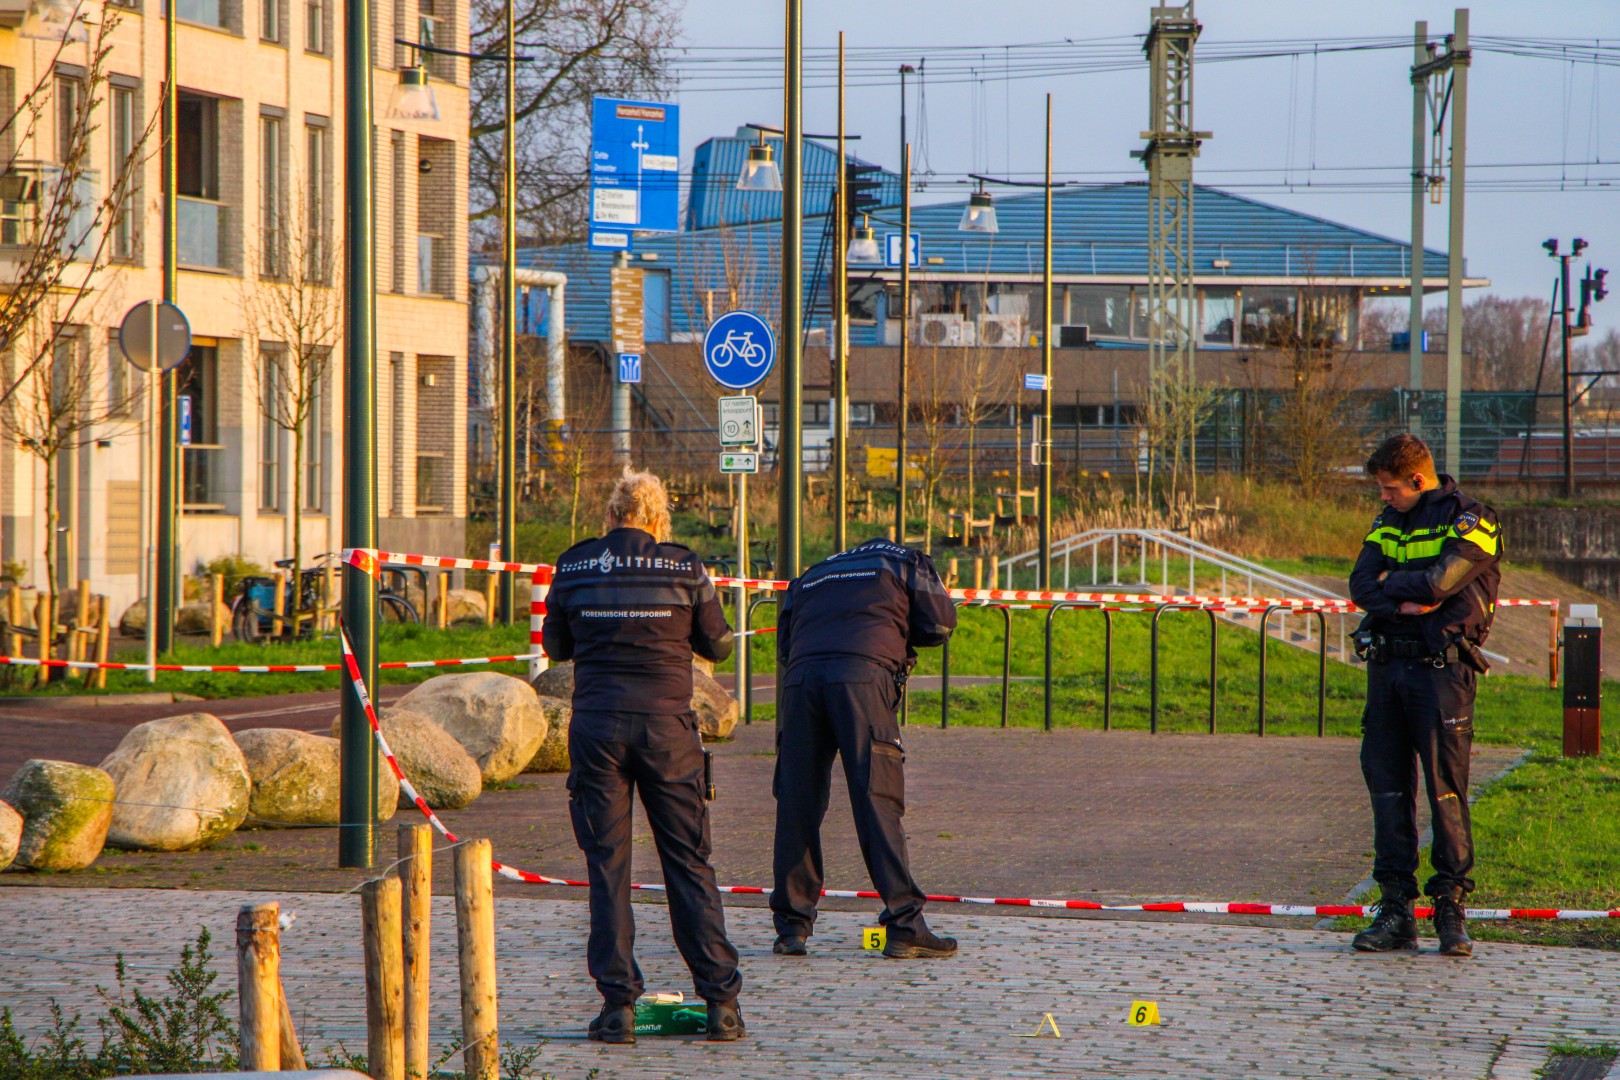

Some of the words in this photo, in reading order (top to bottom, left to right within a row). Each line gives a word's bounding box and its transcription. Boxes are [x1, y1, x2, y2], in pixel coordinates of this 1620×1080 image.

[727, 425, 736, 433] 10
[589, 551, 663, 573] POLITIE
[582, 610, 628, 618] FORENSISCHE
[629, 610, 672, 618] OPSPORING
[870, 933, 880, 948] 5
[1135, 1006, 1146, 1023] 6
